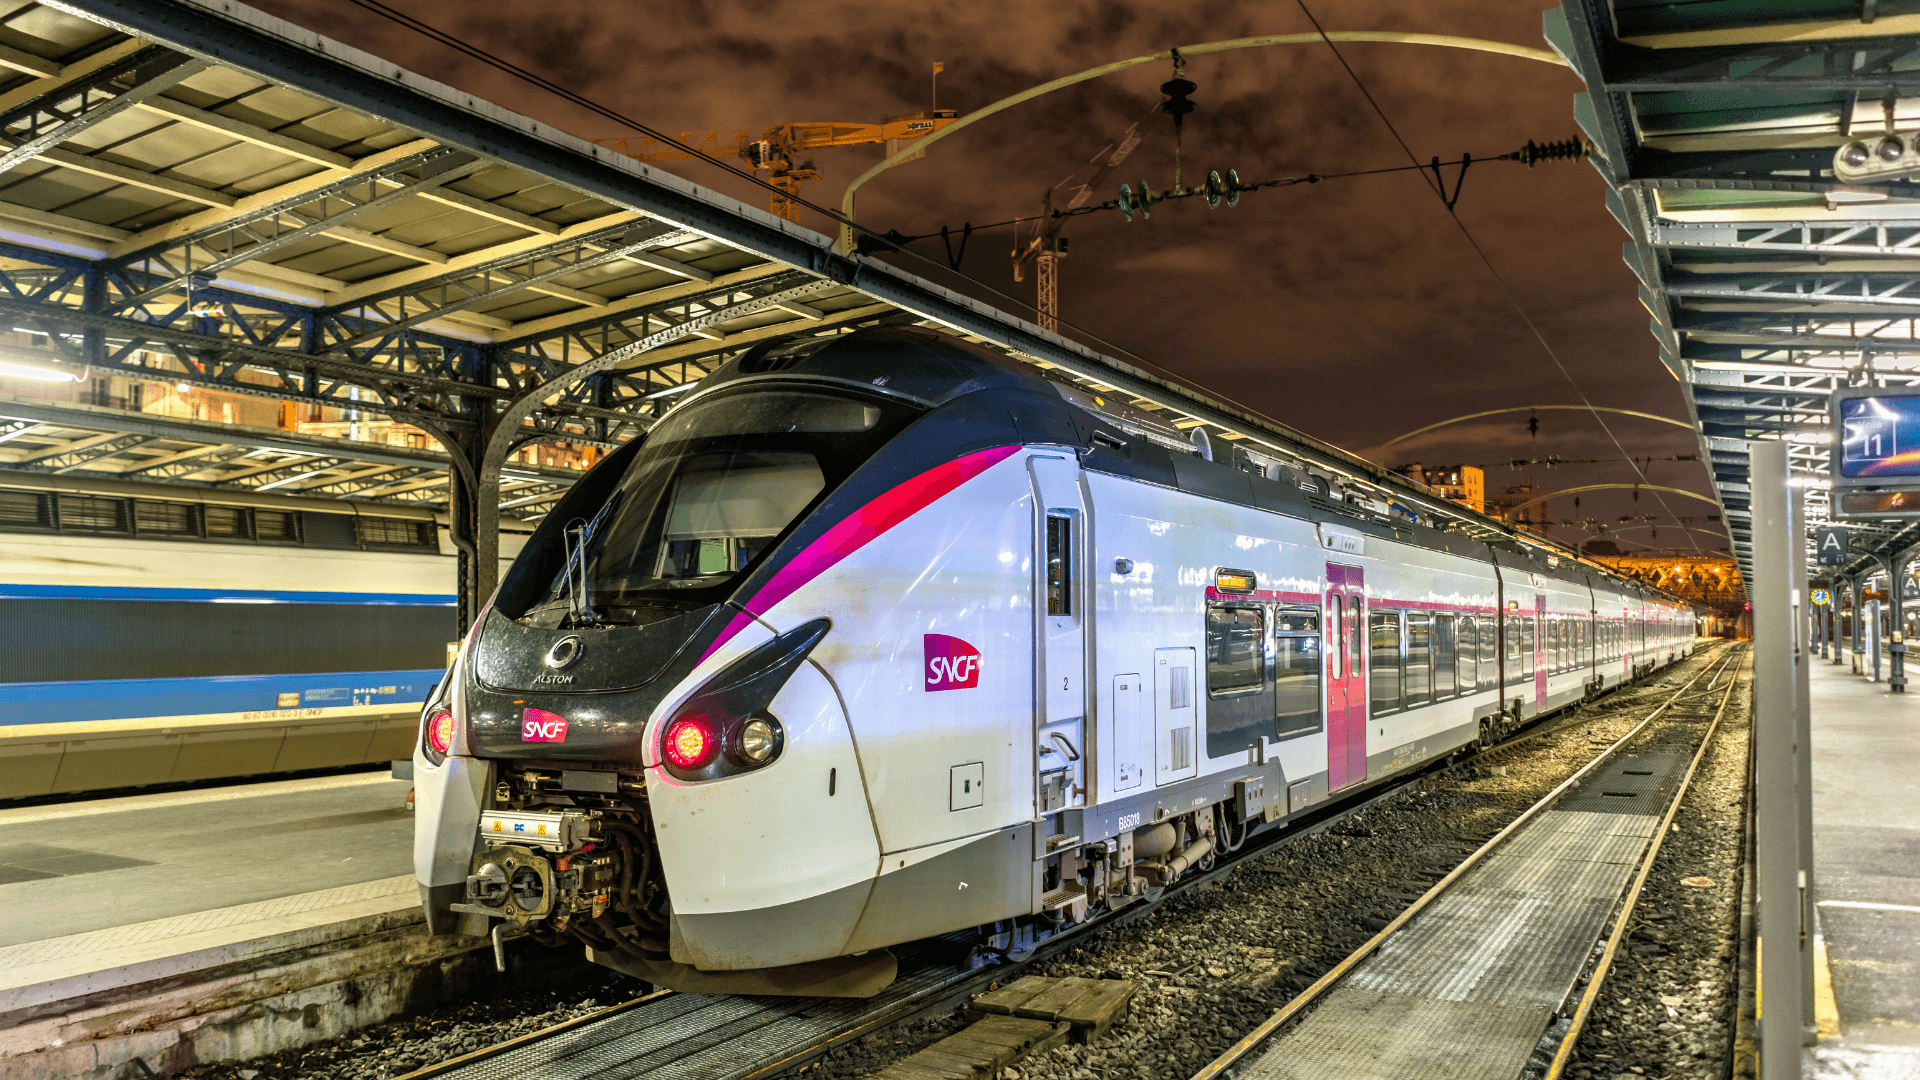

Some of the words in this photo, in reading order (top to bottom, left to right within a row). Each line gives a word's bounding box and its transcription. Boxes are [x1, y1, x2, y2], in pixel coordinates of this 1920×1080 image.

[1862, 433, 1882, 456] 11
[1822, 532, 1841, 550] A
[1905, 577, 1917, 588] A
[927, 655, 978, 684] SNCF
[533, 675, 574, 684] ALSTOM
[1063, 677, 1069, 691] 2
[523, 721, 566, 738] SNCF
